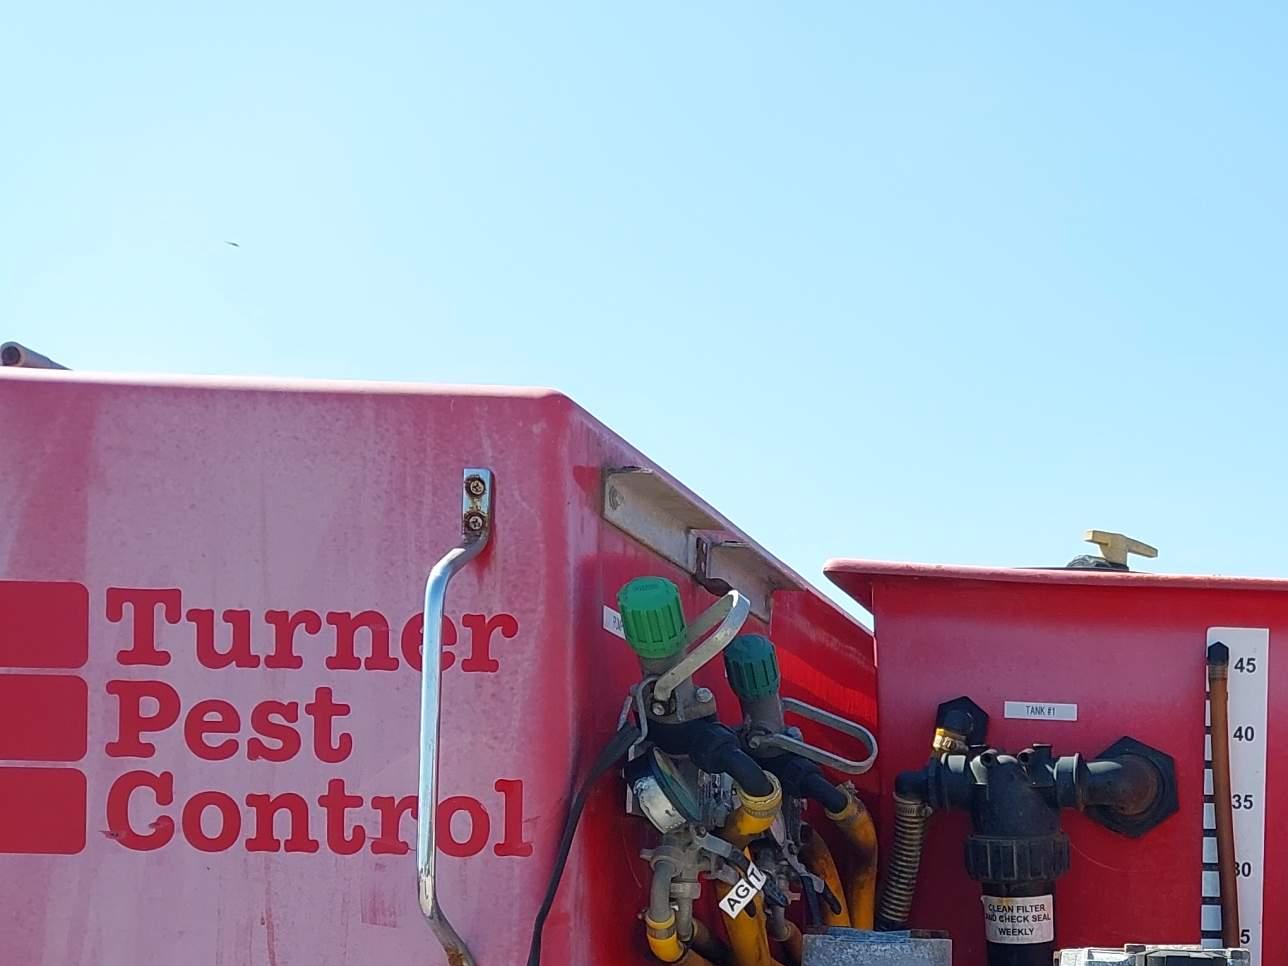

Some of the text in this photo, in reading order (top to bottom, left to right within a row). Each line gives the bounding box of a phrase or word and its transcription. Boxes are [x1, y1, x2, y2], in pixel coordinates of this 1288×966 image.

[105, 587, 518, 673] Turner
[1234, 657, 1257, 674] 45
[1025, 705, 1056, 717] TANK #1
[105, 679, 353, 763] Pest
[1232, 726, 1255, 742] 40
[1231, 794, 1254, 810] 35
[105, 770, 534, 858] Control
[988, 903, 1046, 913] CLEAN FILTER
[998, 914, 1030, 924] CHECK
[1031, 913, 1051, 923] SEAL
[998, 927, 1035, 936] WEEKLY
